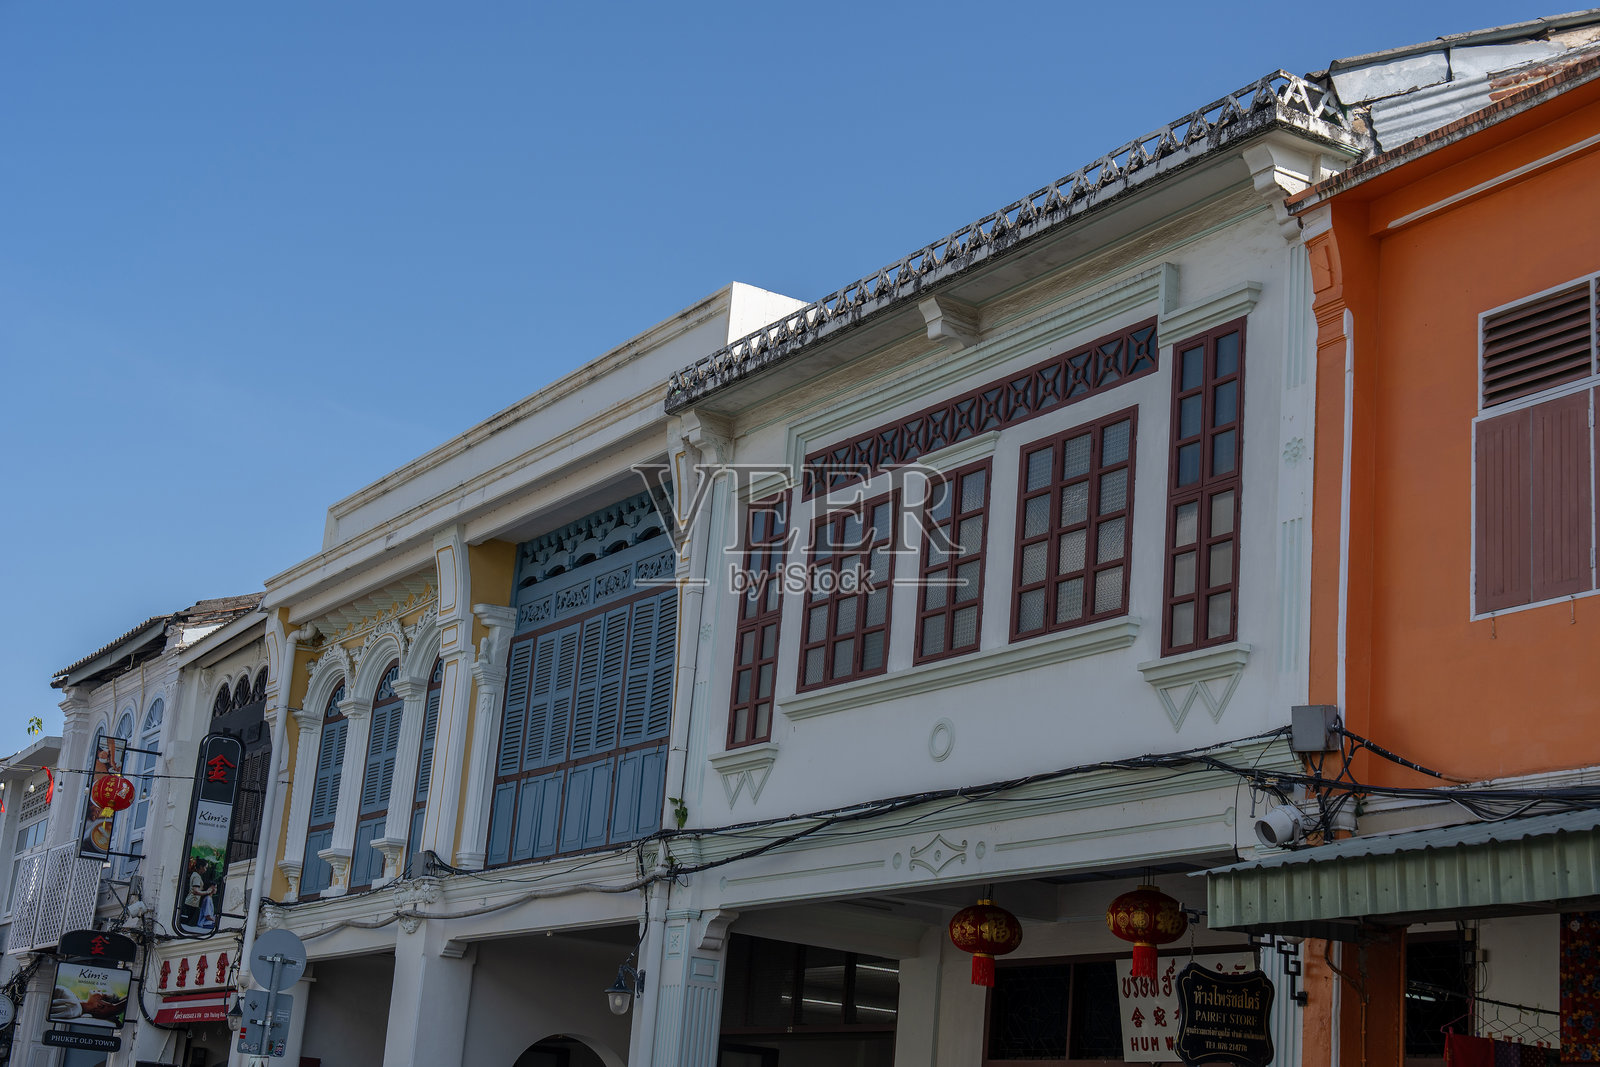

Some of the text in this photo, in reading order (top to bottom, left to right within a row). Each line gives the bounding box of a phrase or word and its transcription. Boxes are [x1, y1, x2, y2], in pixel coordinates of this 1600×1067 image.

[198, 810, 228, 823] Kim's
[78, 968, 109, 980] Kim's
[51, 1035, 115, 1047] PHUKET OLD TOWN
[1131, 1036, 1159, 1052] HUM
